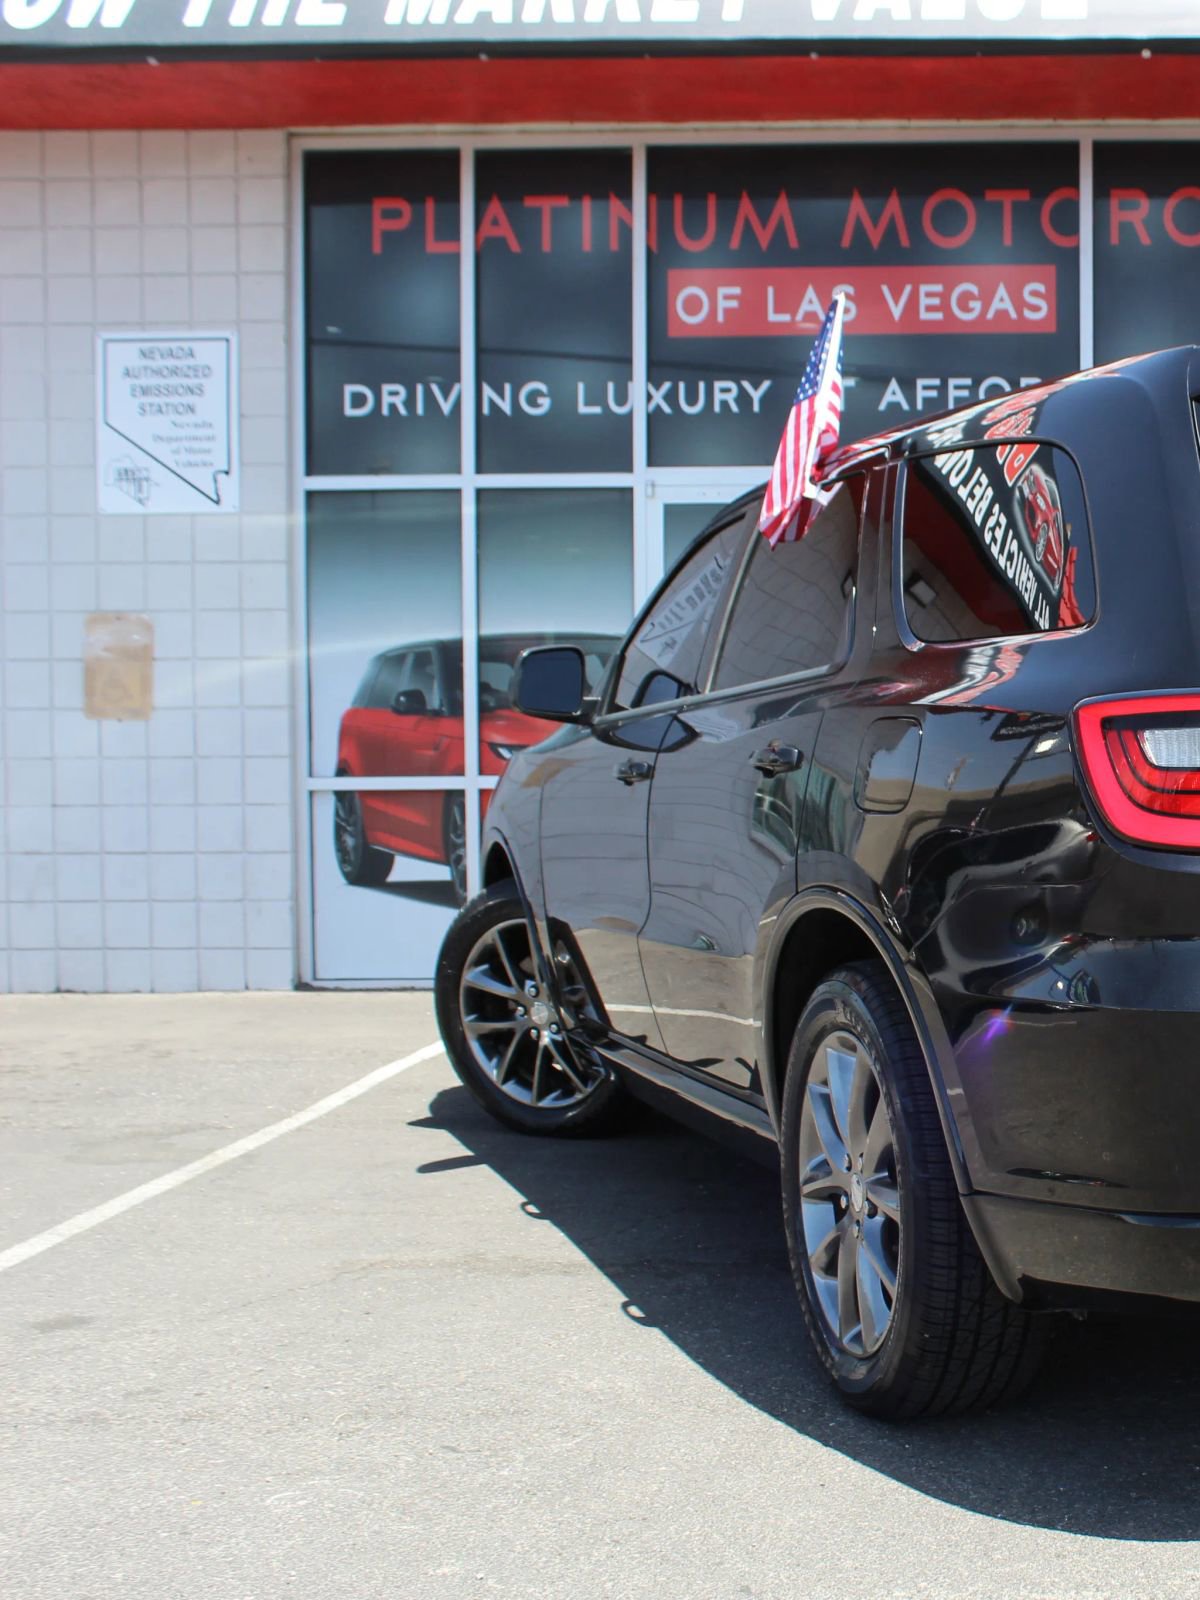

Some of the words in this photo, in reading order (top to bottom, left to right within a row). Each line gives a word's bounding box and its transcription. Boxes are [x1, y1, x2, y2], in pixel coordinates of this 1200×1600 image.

[371, 189, 799, 255] PLATINUM
[675, 287, 742, 325] OF
[766, 284, 857, 323] LAS
[881, 282, 1049, 321] VEGAS
[138, 346, 196, 360] NEVADA
[122, 365, 213, 379] AUTHORIZED
[129, 384, 205, 398] EMISSIONS
[343, 380, 551, 417] DRIVNG
[577, 379, 771, 415] LUXURY
[138, 403, 196, 416] STATION
